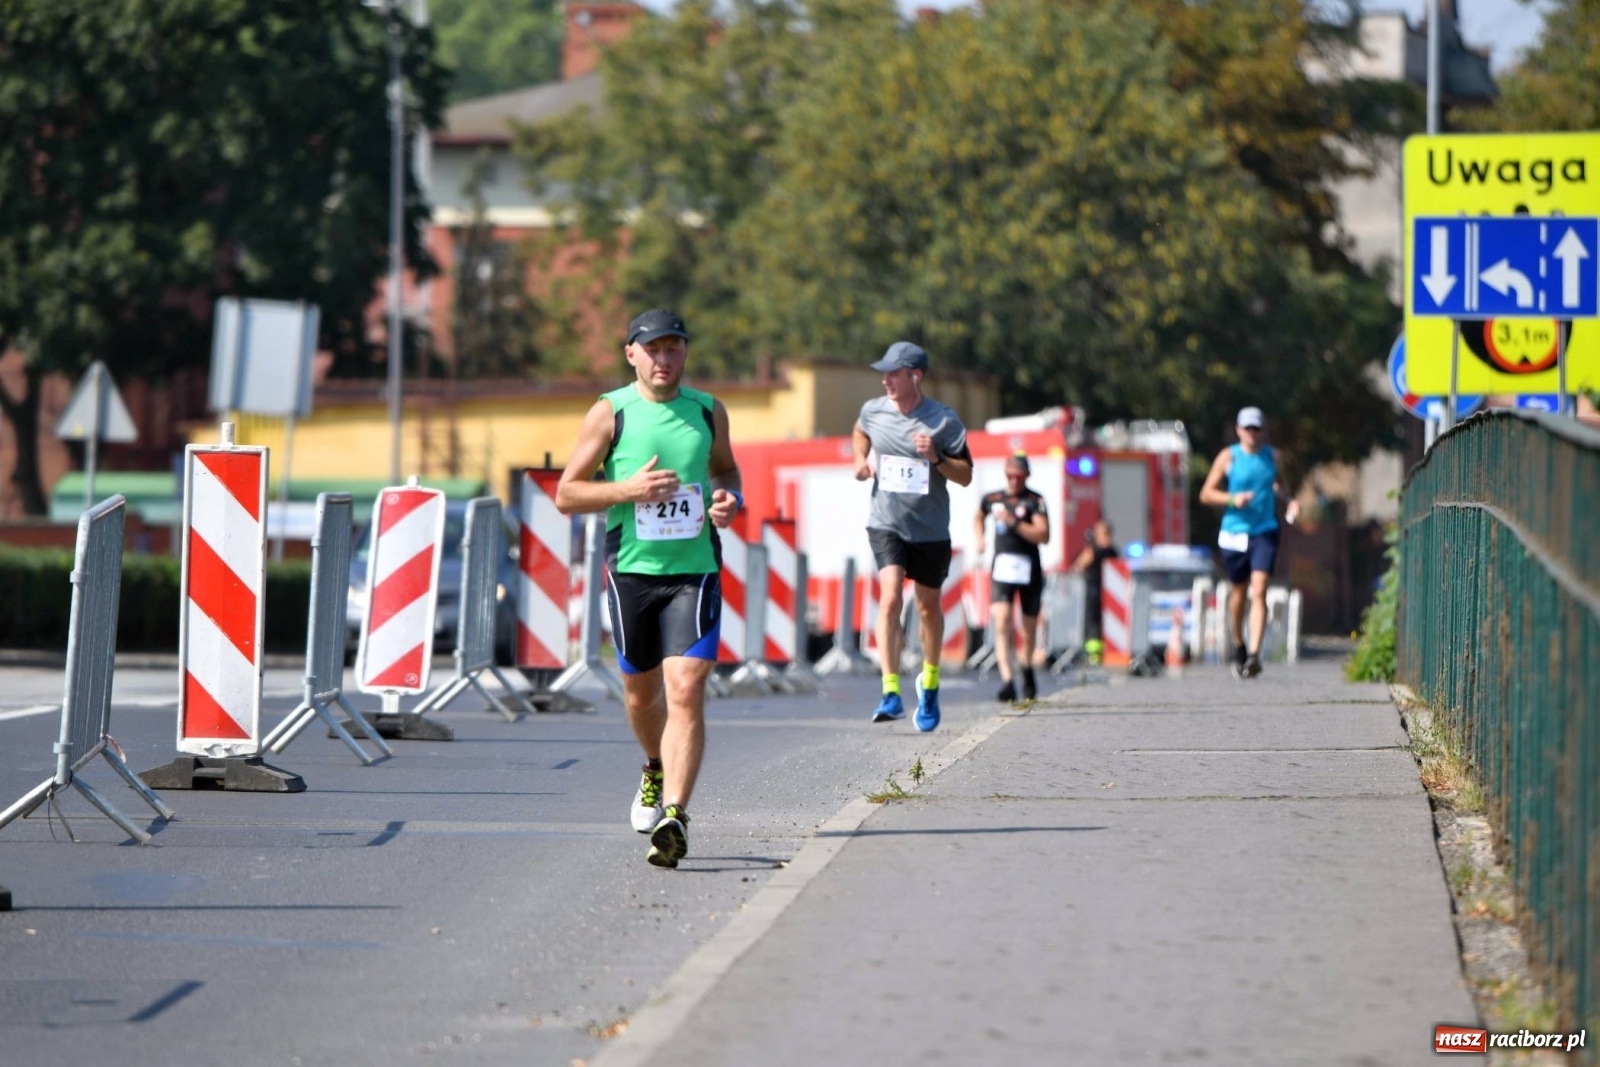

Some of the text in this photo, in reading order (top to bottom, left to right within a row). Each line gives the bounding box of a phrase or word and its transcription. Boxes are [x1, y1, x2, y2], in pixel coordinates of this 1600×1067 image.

[1428, 149, 1587, 196] Uwaga
[901, 467, 913, 478] 15
[657, 500, 690, 518] 274
